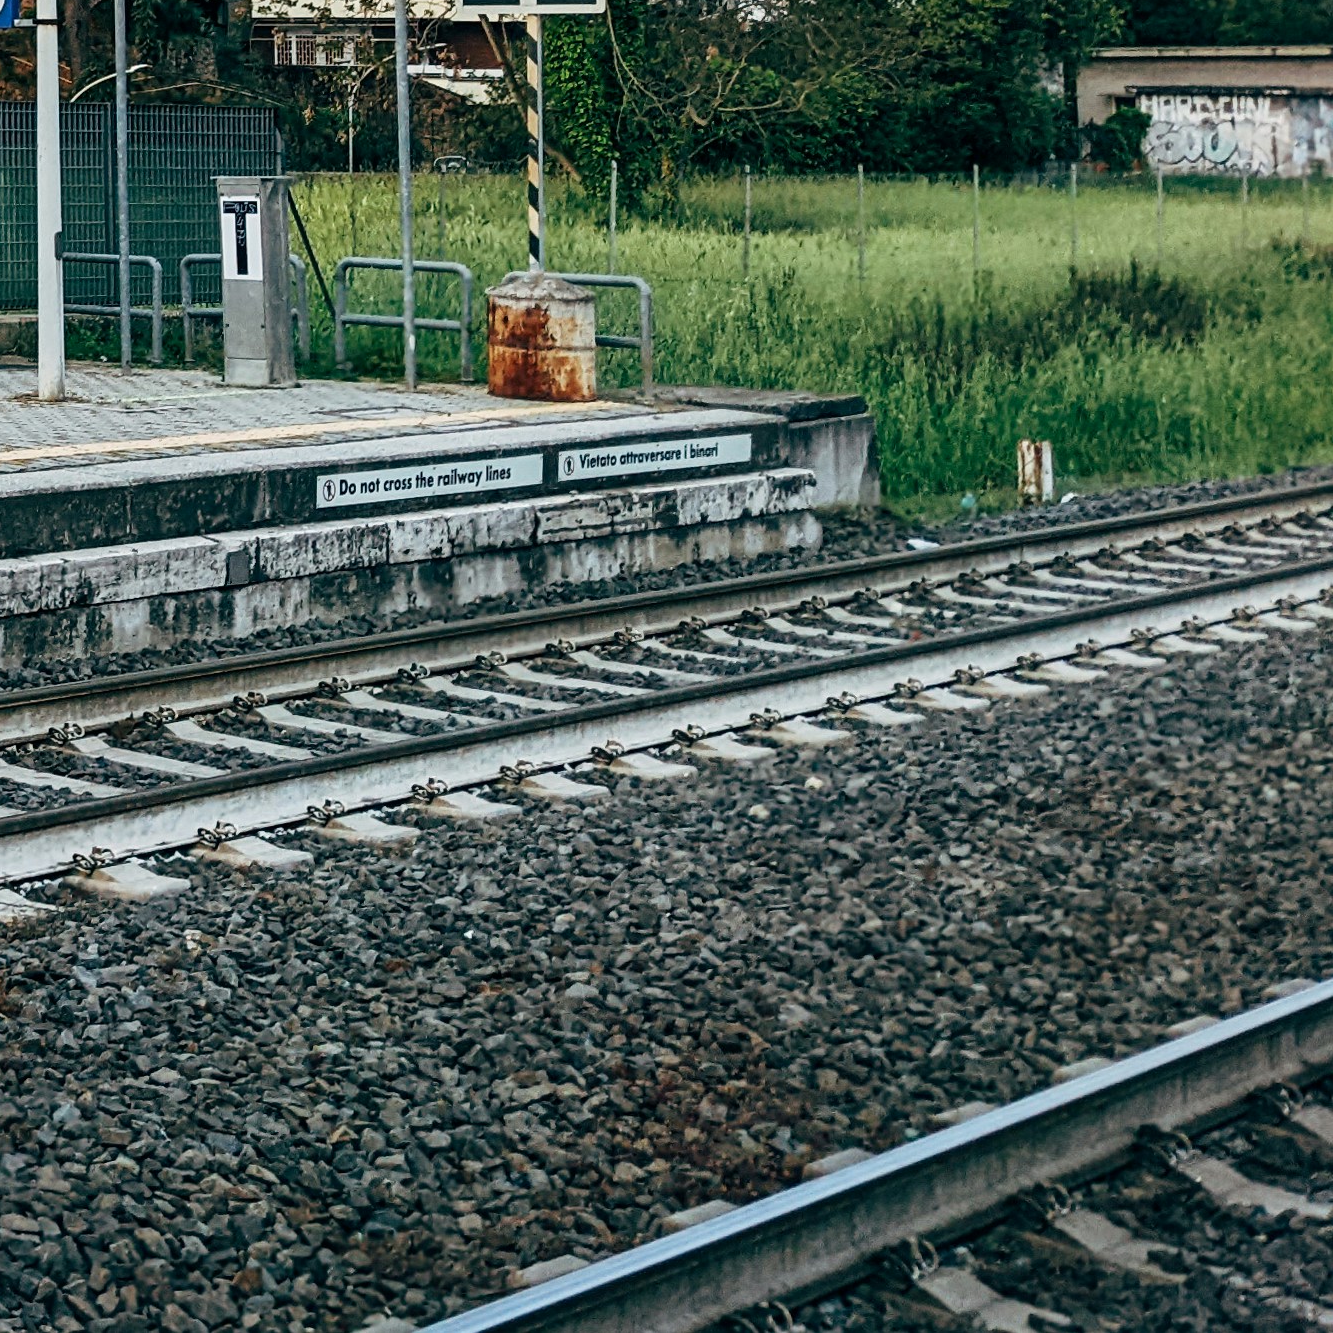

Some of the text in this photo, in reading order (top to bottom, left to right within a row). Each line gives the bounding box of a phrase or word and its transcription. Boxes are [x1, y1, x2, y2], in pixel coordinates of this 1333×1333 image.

[223, 200, 258, 276] T
[579, 442, 719, 470] Vietato attraversare i binari
[339, 465, 512, 496] Do not cross the railway lines
